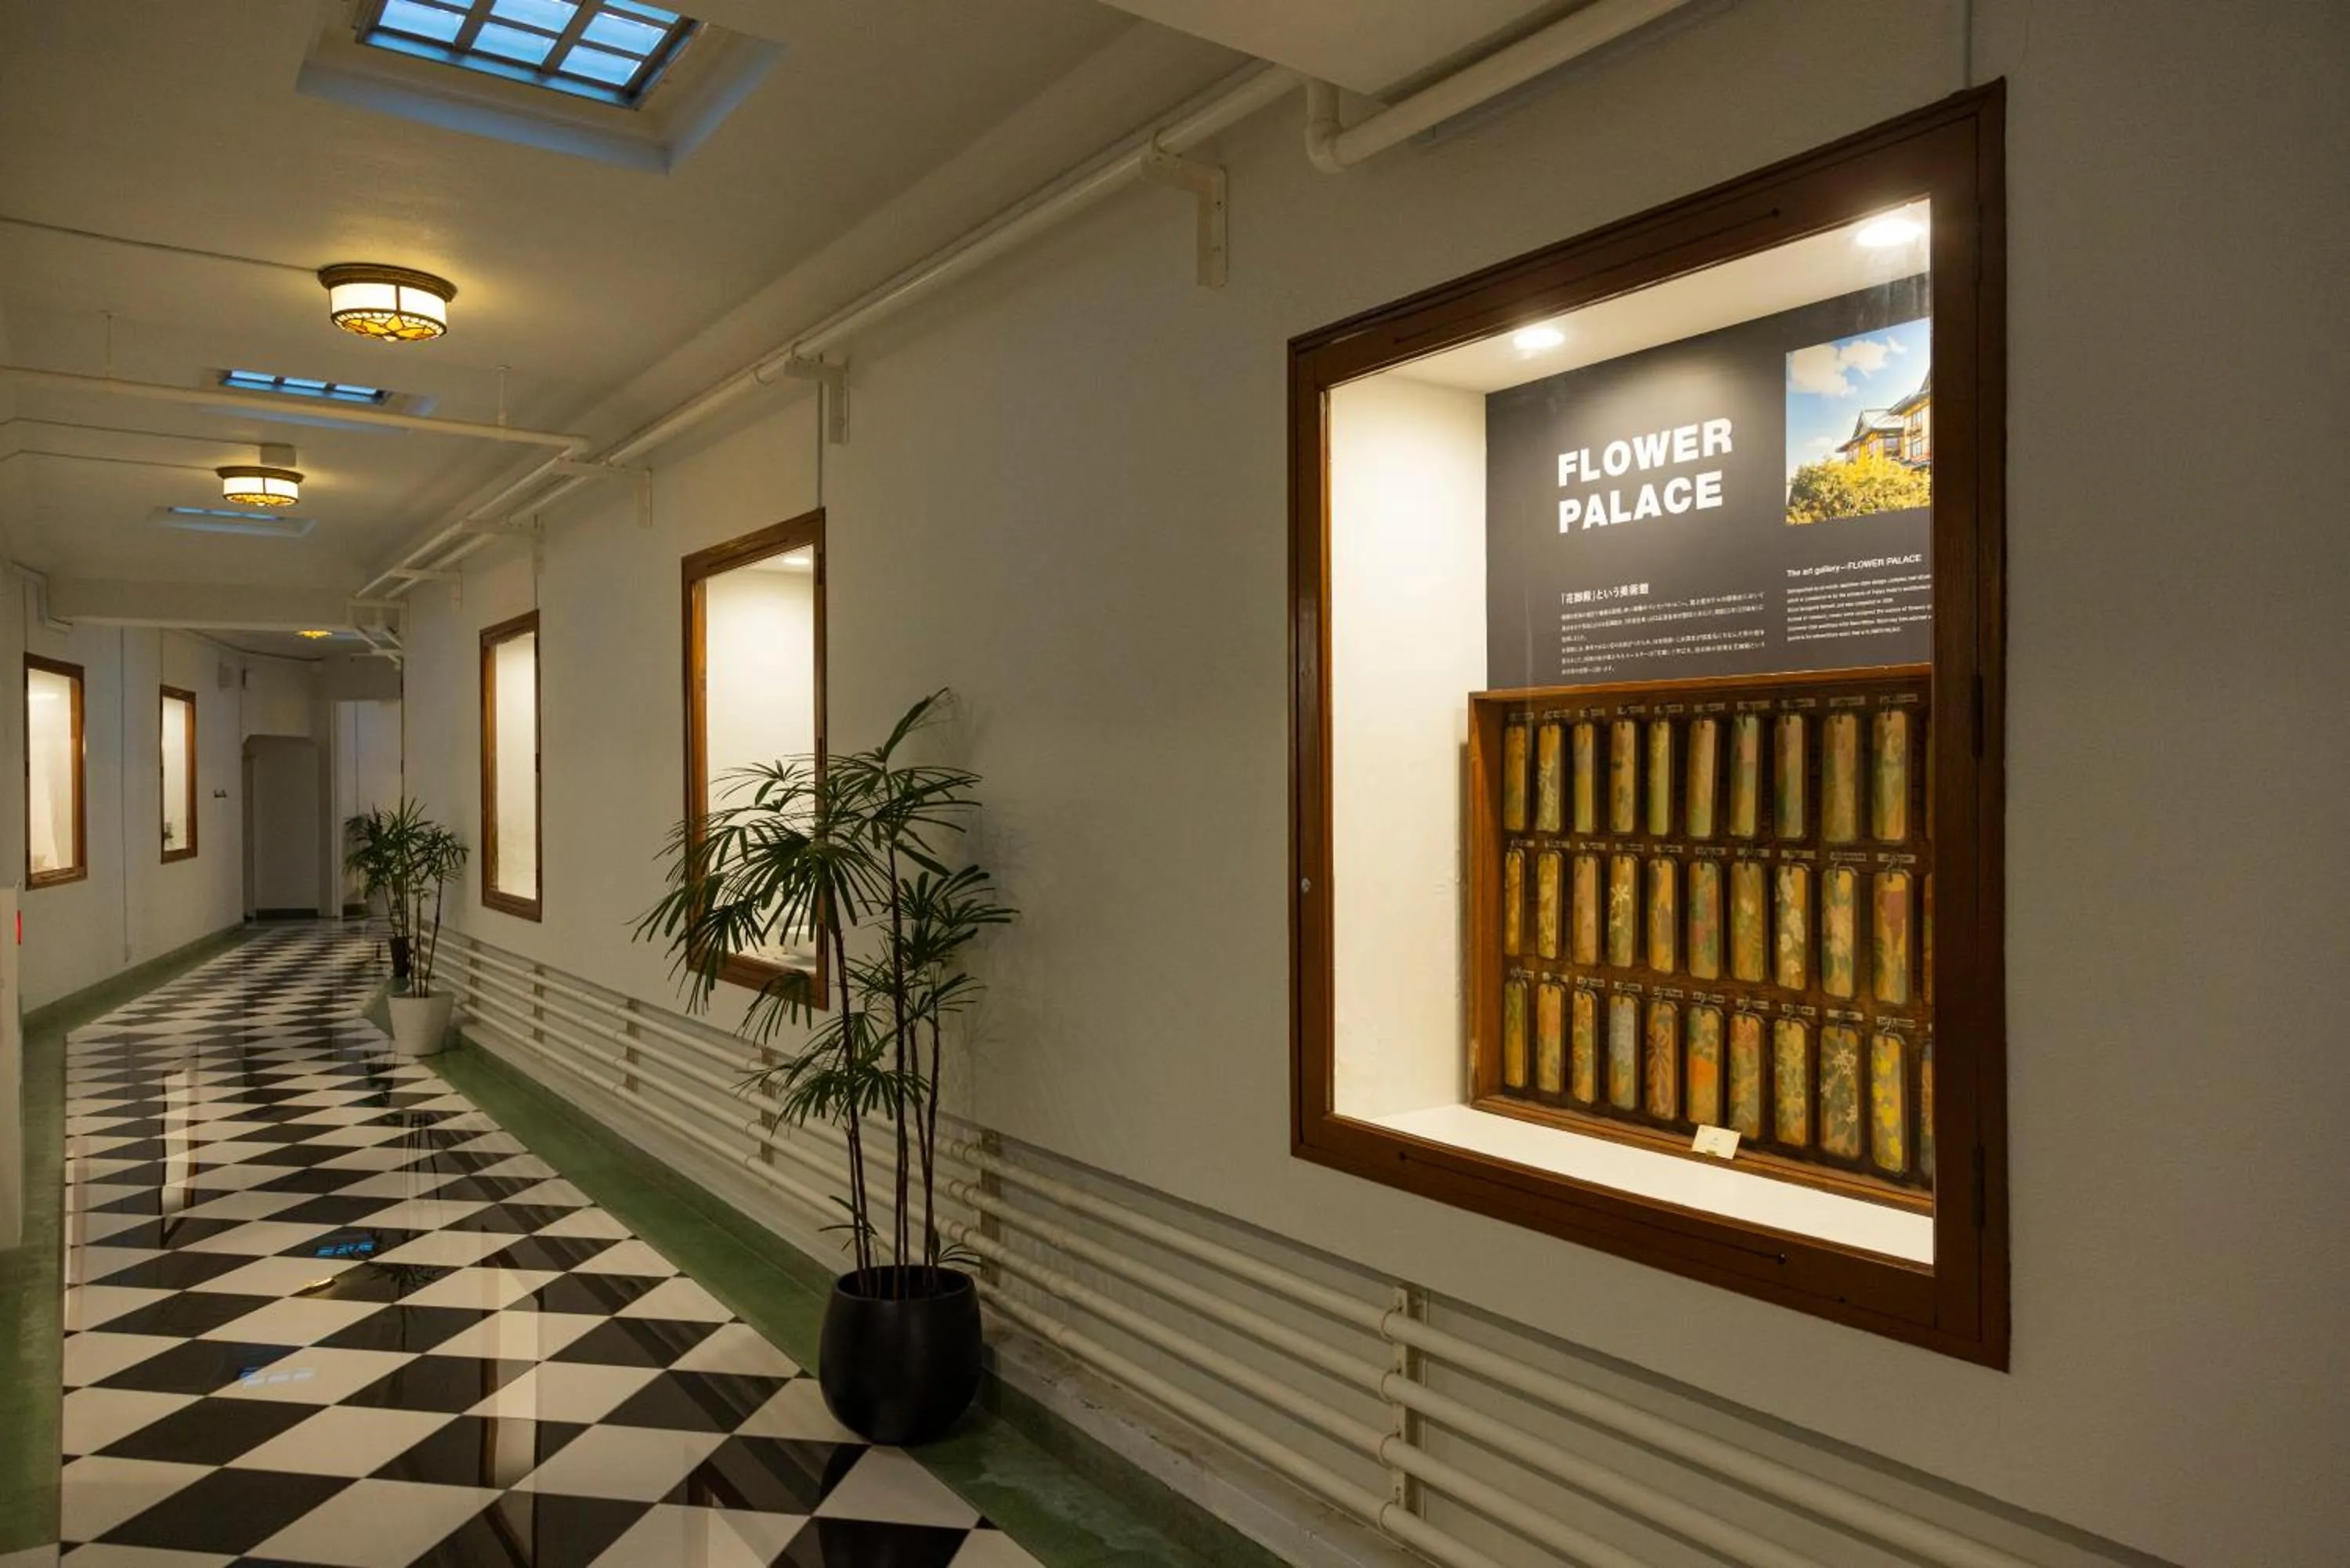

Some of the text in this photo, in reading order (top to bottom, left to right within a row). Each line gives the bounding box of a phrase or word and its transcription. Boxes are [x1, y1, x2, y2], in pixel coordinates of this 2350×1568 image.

[1558, 417, 1733, 488] FLOWER
[1559, 470, 1723, 533] PALACE
[1802, 567, 1813, 576] art
[1885, 554, 1922, 566] PALACE
